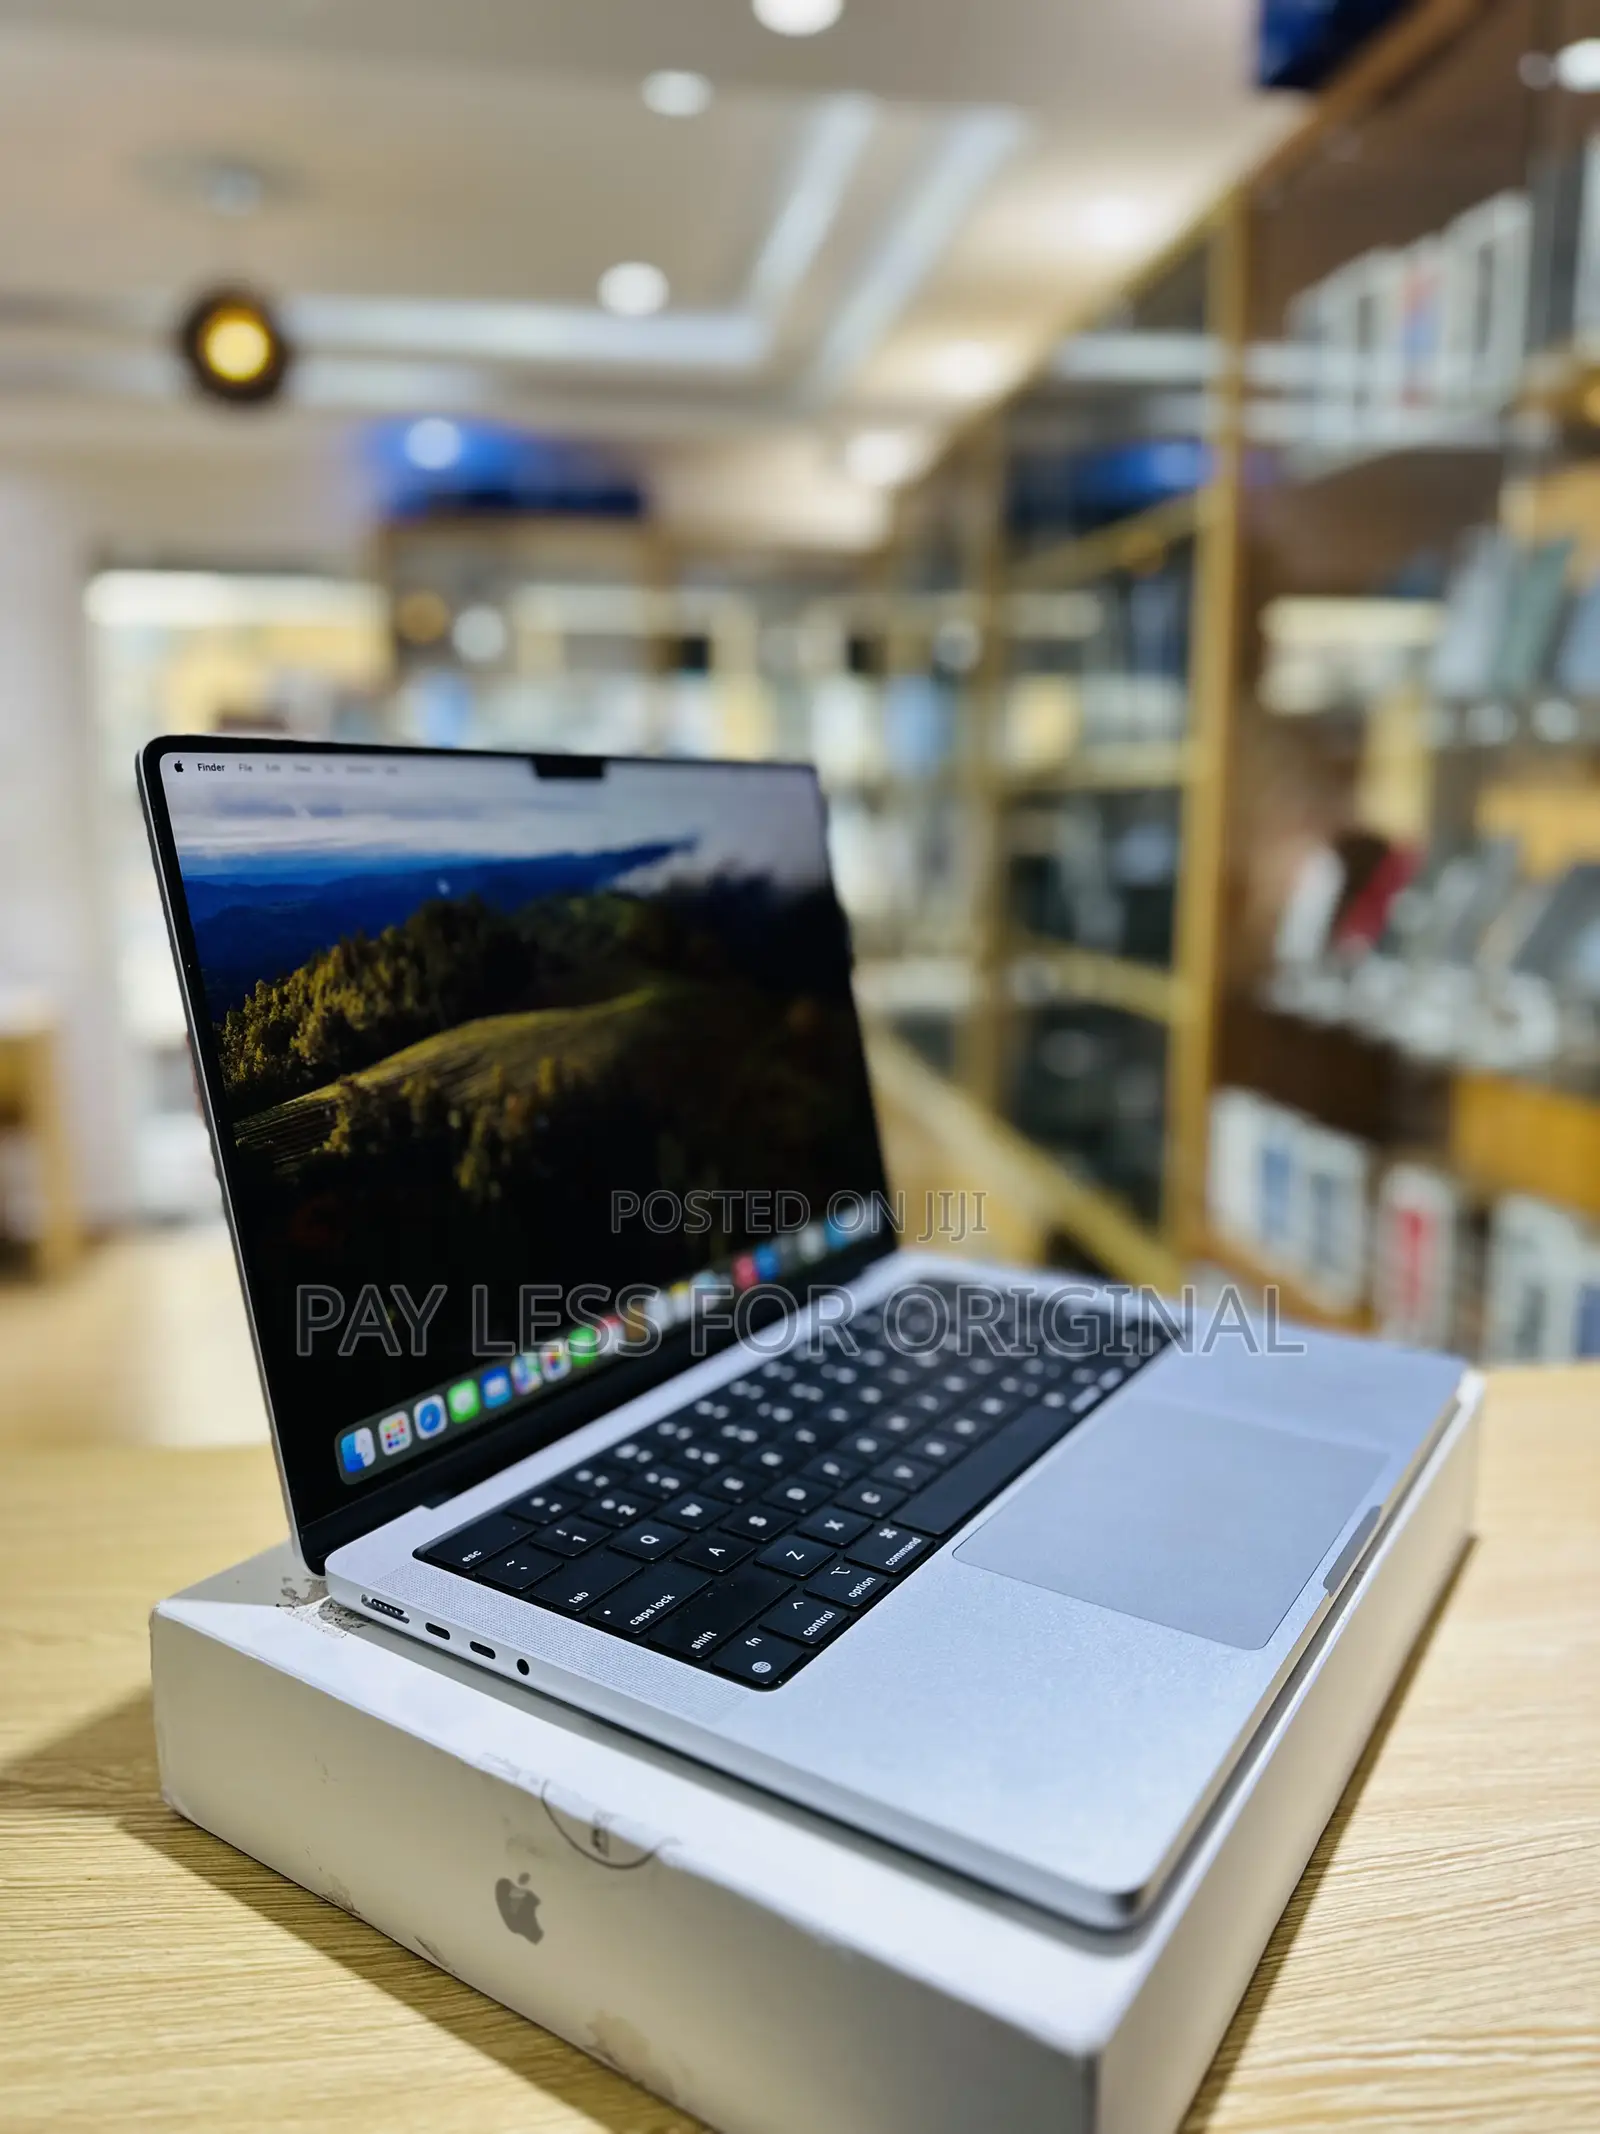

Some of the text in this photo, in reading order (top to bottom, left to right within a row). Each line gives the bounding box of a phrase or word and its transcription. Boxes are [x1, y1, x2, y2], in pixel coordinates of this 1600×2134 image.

[197, 763, 225, 772] Finder
[617, 1504, 637, 1516] 2
[748, 1515, 767, 1527] S
[824, 1518, 844, 1531] X
[640, 1535, 660, 1544] Q
[462, 1549, 482, 1562] esc
[708, 1547, 725, 1556] A
[786, 1550, 804, 1561] Z
[885, 1537, 922, 1567] command
[848, 1575, 876, 1599] option
[568, 1591, 589, 1604] tab
[629, 1593, 675, 1626] caps lock
[803, 1610, 835, 1637] control
[691, 1630, 717, 1650] shift
[745, 1636, 762, 1648] fn
